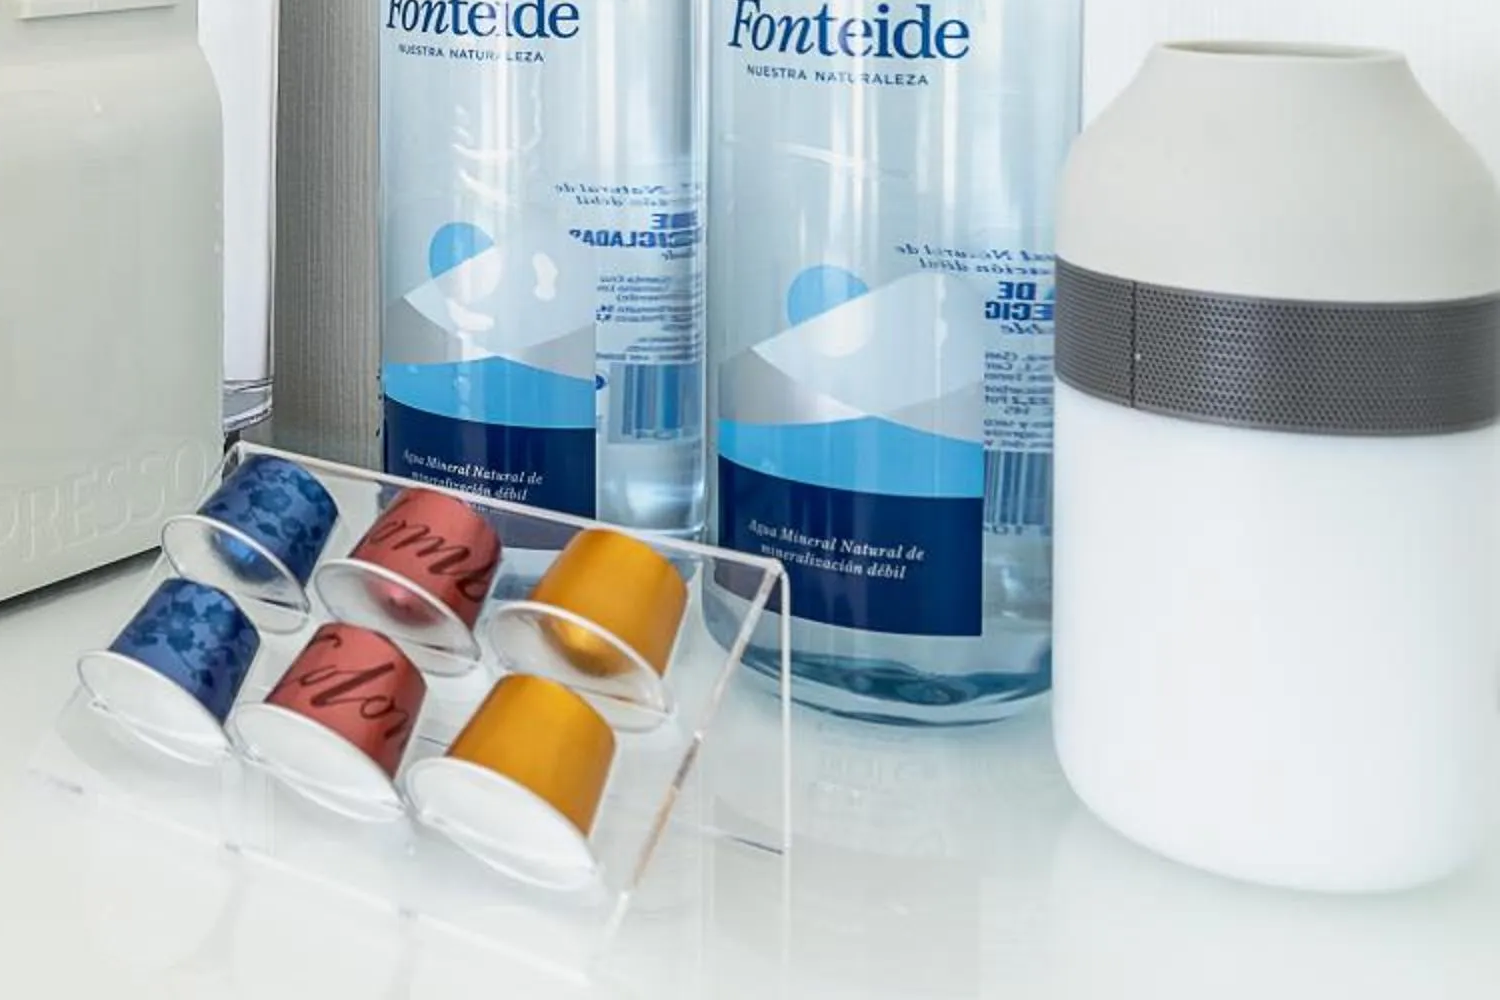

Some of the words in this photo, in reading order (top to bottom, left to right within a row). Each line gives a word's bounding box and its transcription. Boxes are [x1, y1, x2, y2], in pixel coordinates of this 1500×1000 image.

[398, 43, 444, 58] NUESTRA
[450, 49, 545, 64] NATURLEZA
[747, 63, 807, 81] NUESTRA
[425, 455, 472, 478] Mineral
[472, 465, 525, 483] Natural
[527, 472, 544, 486] de
[748, 519, 778, 538] Agua
[781, 527, 838, 550] Mineral
[840, 539, 904, 559] Natural
[905, 546, 926, 562] de
[761, 543, 864, 577] mineralización
[867, 563, 908, 580] débil
